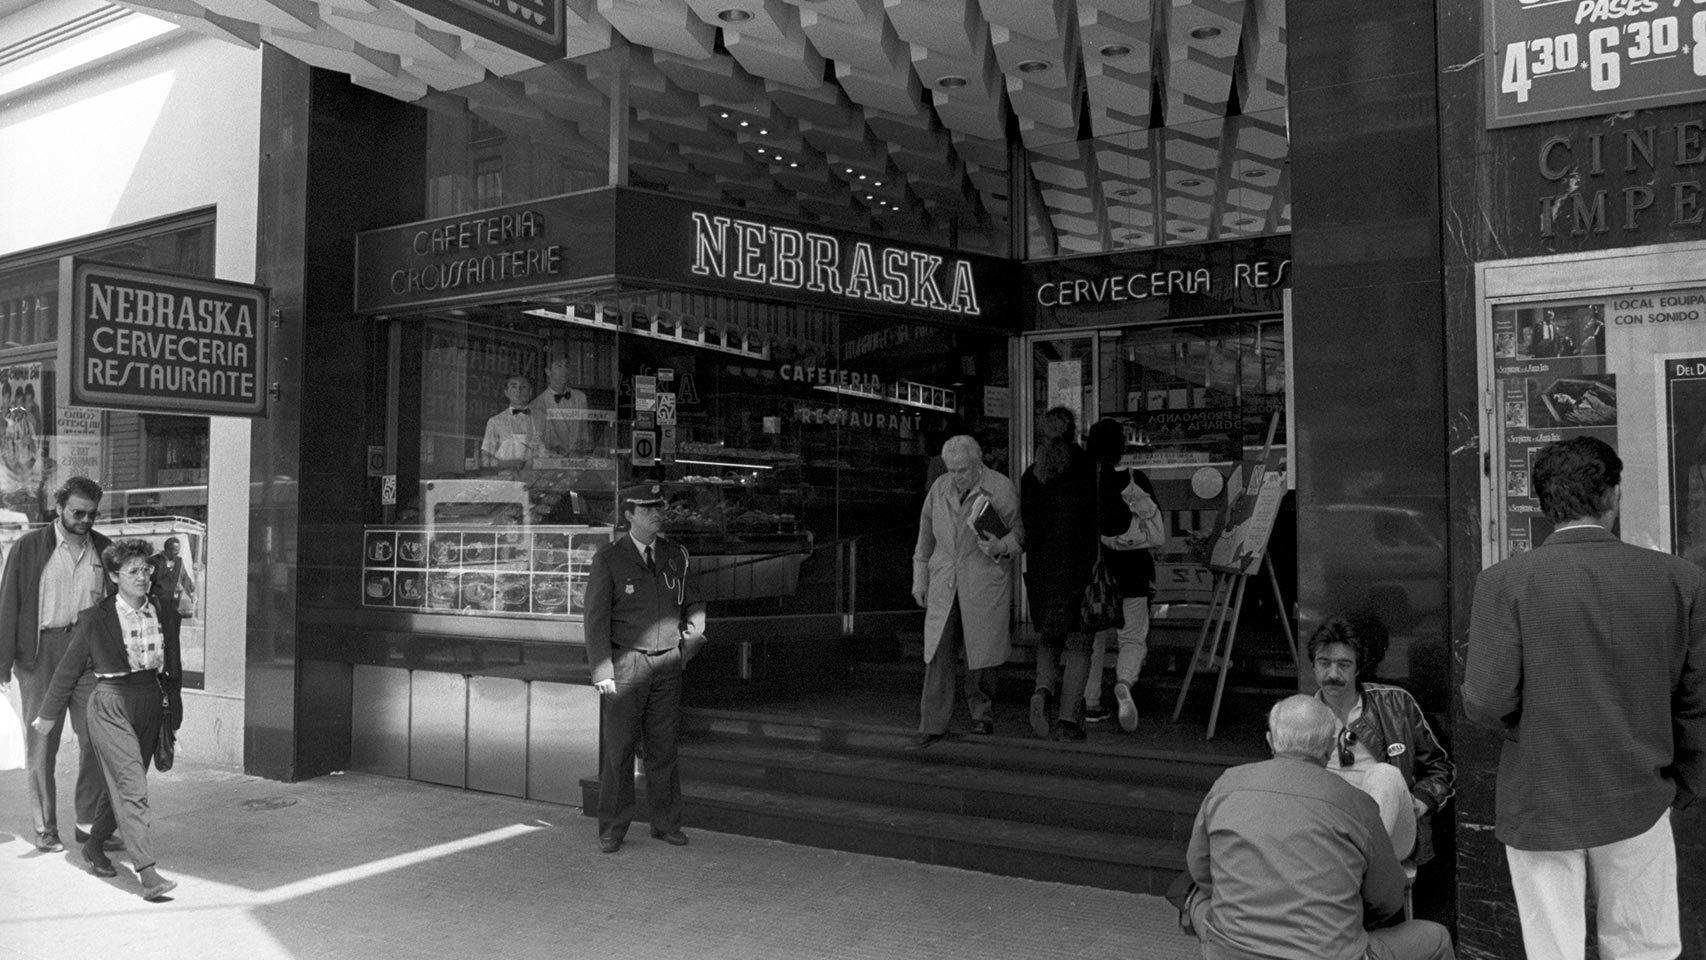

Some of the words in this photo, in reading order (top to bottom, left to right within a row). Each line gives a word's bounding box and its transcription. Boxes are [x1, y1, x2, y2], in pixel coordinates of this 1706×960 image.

[1575, 0, 1659, 25] PASES
[1538, 119, 1706, 181] CINE
[413, 209, 537, 257] CAFETERIA
[1538, 180, 1706, 239] IMPE
[390, 243, 561, 296] CROISSANTERIE
[692, 212, 980, 315] NEBRASKA
[1037, 268, 1211, 306] CERVECERIA
[1234, 259, 1292, 290] RES
[88, 281, 255, 339] NEBRASKA
[1613, 298, 1655, 311] LOCAL
[1659, 294, 1706, 308] EQUIPA
[1614, 314, 1643, 326] CON
[1647, 310, 1699, 324] SONIDO
[92, 326, 248, 369] CERVECERIA
[87, 357, 254, 398] RESTAURANTE
[779, 363, 881, 389] CAFETERIA
